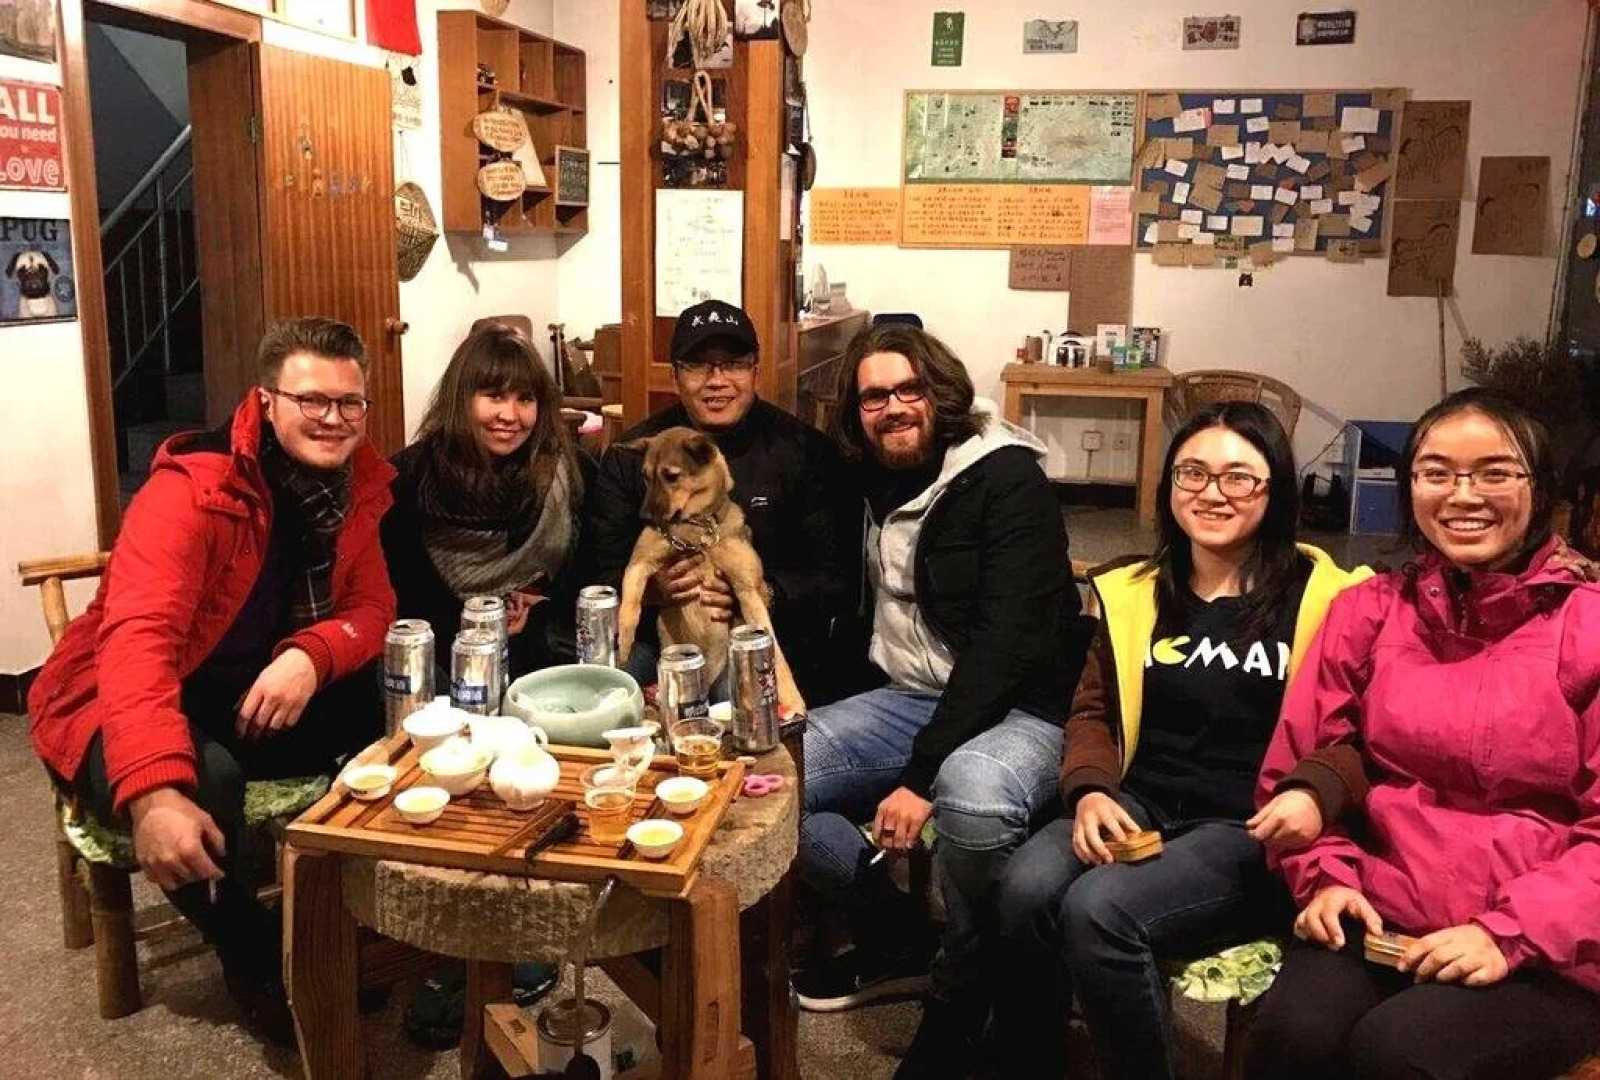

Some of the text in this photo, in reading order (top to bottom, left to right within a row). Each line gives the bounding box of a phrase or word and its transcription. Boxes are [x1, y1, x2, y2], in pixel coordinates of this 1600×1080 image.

[0, 86, 56, 125] ALL
[0, 124, 57, 143] ou need
[0, 218, 58, 241] PUG
